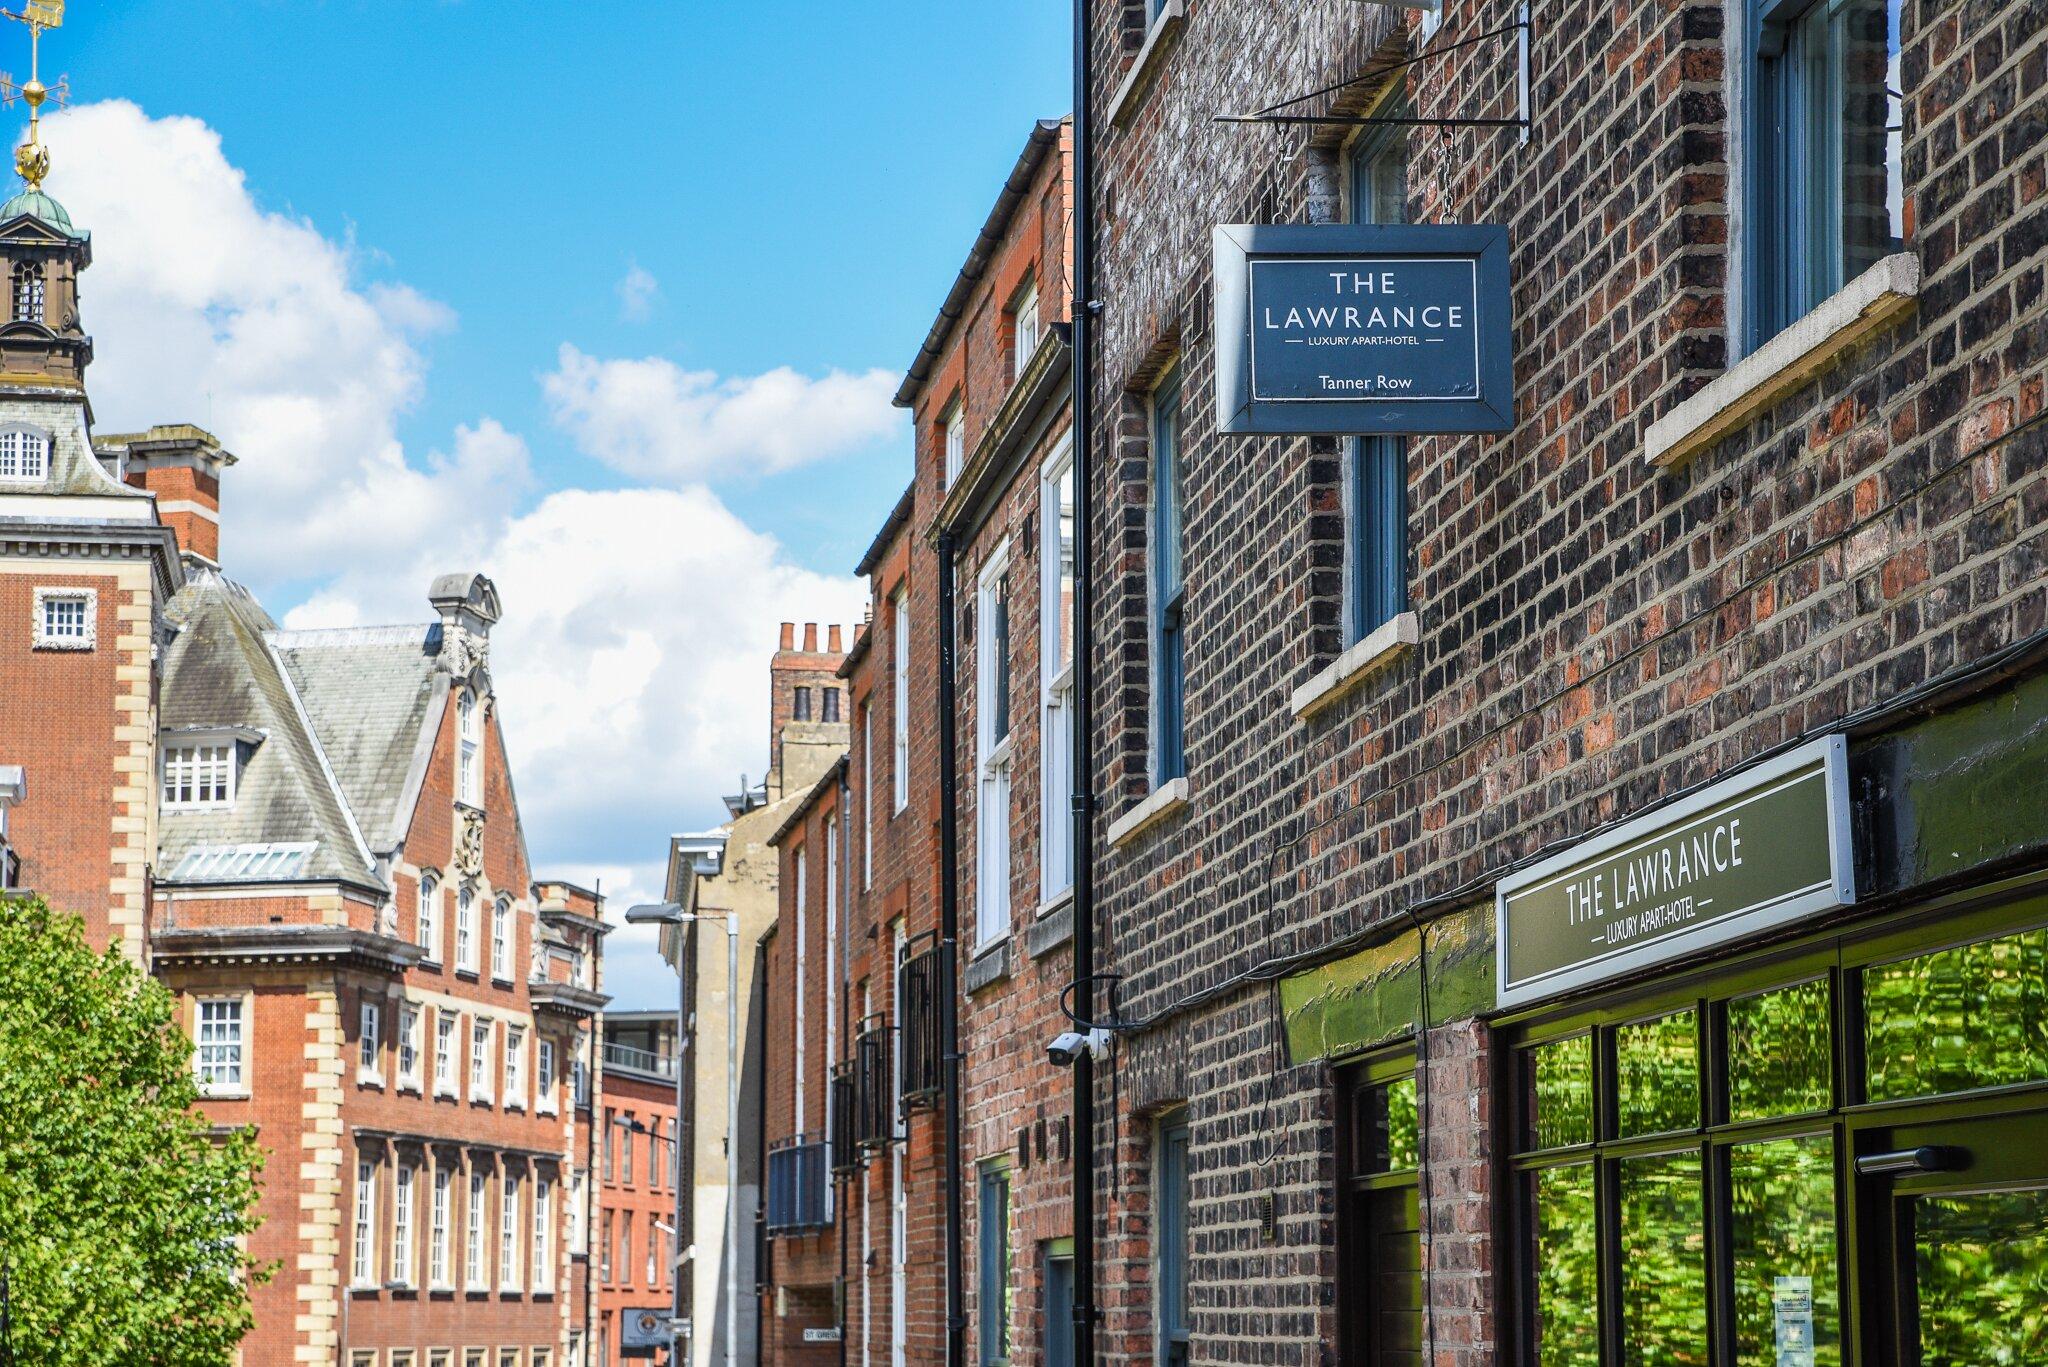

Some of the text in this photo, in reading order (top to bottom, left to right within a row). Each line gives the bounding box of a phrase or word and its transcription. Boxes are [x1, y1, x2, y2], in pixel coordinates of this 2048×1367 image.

[1329, 272, 1396, 294] THE
[1265, 306, 1463, 329] LAWRANCE
[1308, 335, 1420, 346] LUXURY APART-HOTEL
[1318, 375, 1412, 390] Tanner Row
[1565, 818, 1742, 926] THE LAWRANCE
[1606, 895, 1696, 945] LUXURY APART-HOTEL
